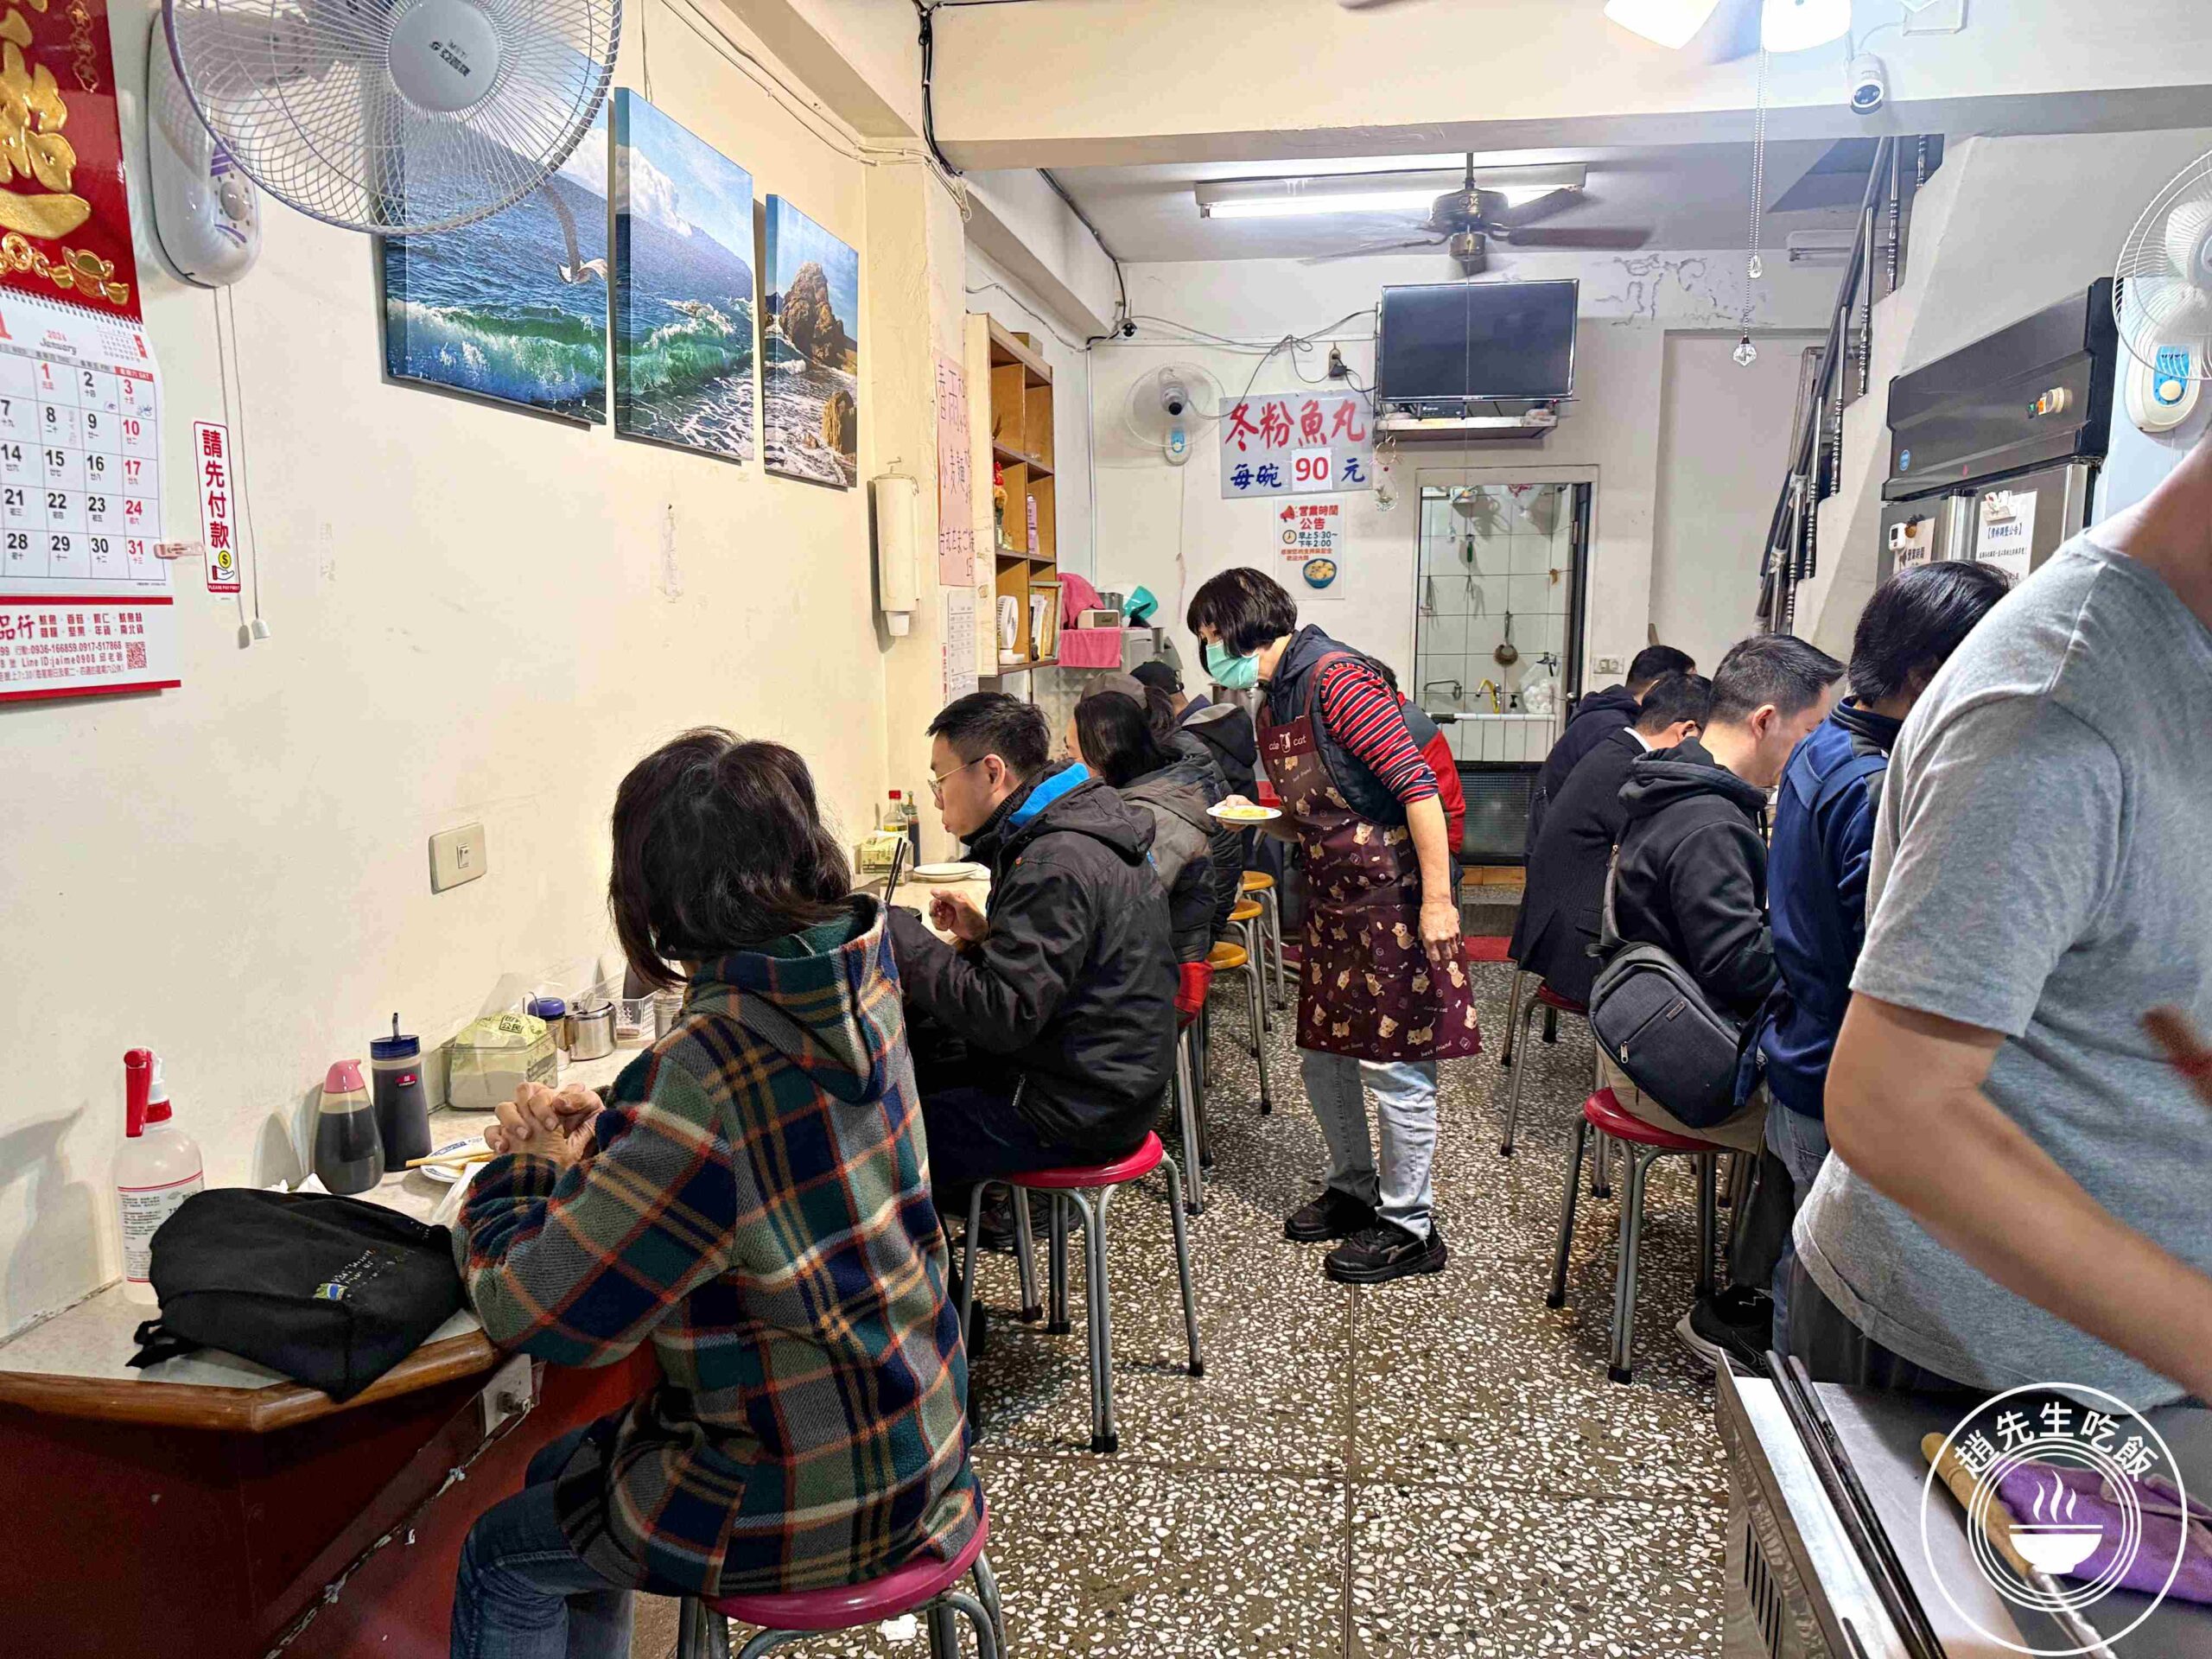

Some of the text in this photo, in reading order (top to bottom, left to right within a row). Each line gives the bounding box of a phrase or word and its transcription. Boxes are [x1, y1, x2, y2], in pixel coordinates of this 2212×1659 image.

[41, 363, 133, 394] 1 2 3
[0, 399, 10, 416] 7
[46, 406, 56, 423] 8
[87, 413, 97, 429] 9
[123, 419, 140, 435] 10
[1225, 400, 1365, 452] 冬粉魚丸
[1, 443, 141, 475] 14 15 16 17
[1230, 457, 1365, 490] 每碗 90 元
[4, 488, 143, 515] 21 22 23 24
[202, 429, 231, 550] 請先付款
[1300, 518, 1325, 530] 公告
[7, 533, 143, 555] 28 29 30 31
